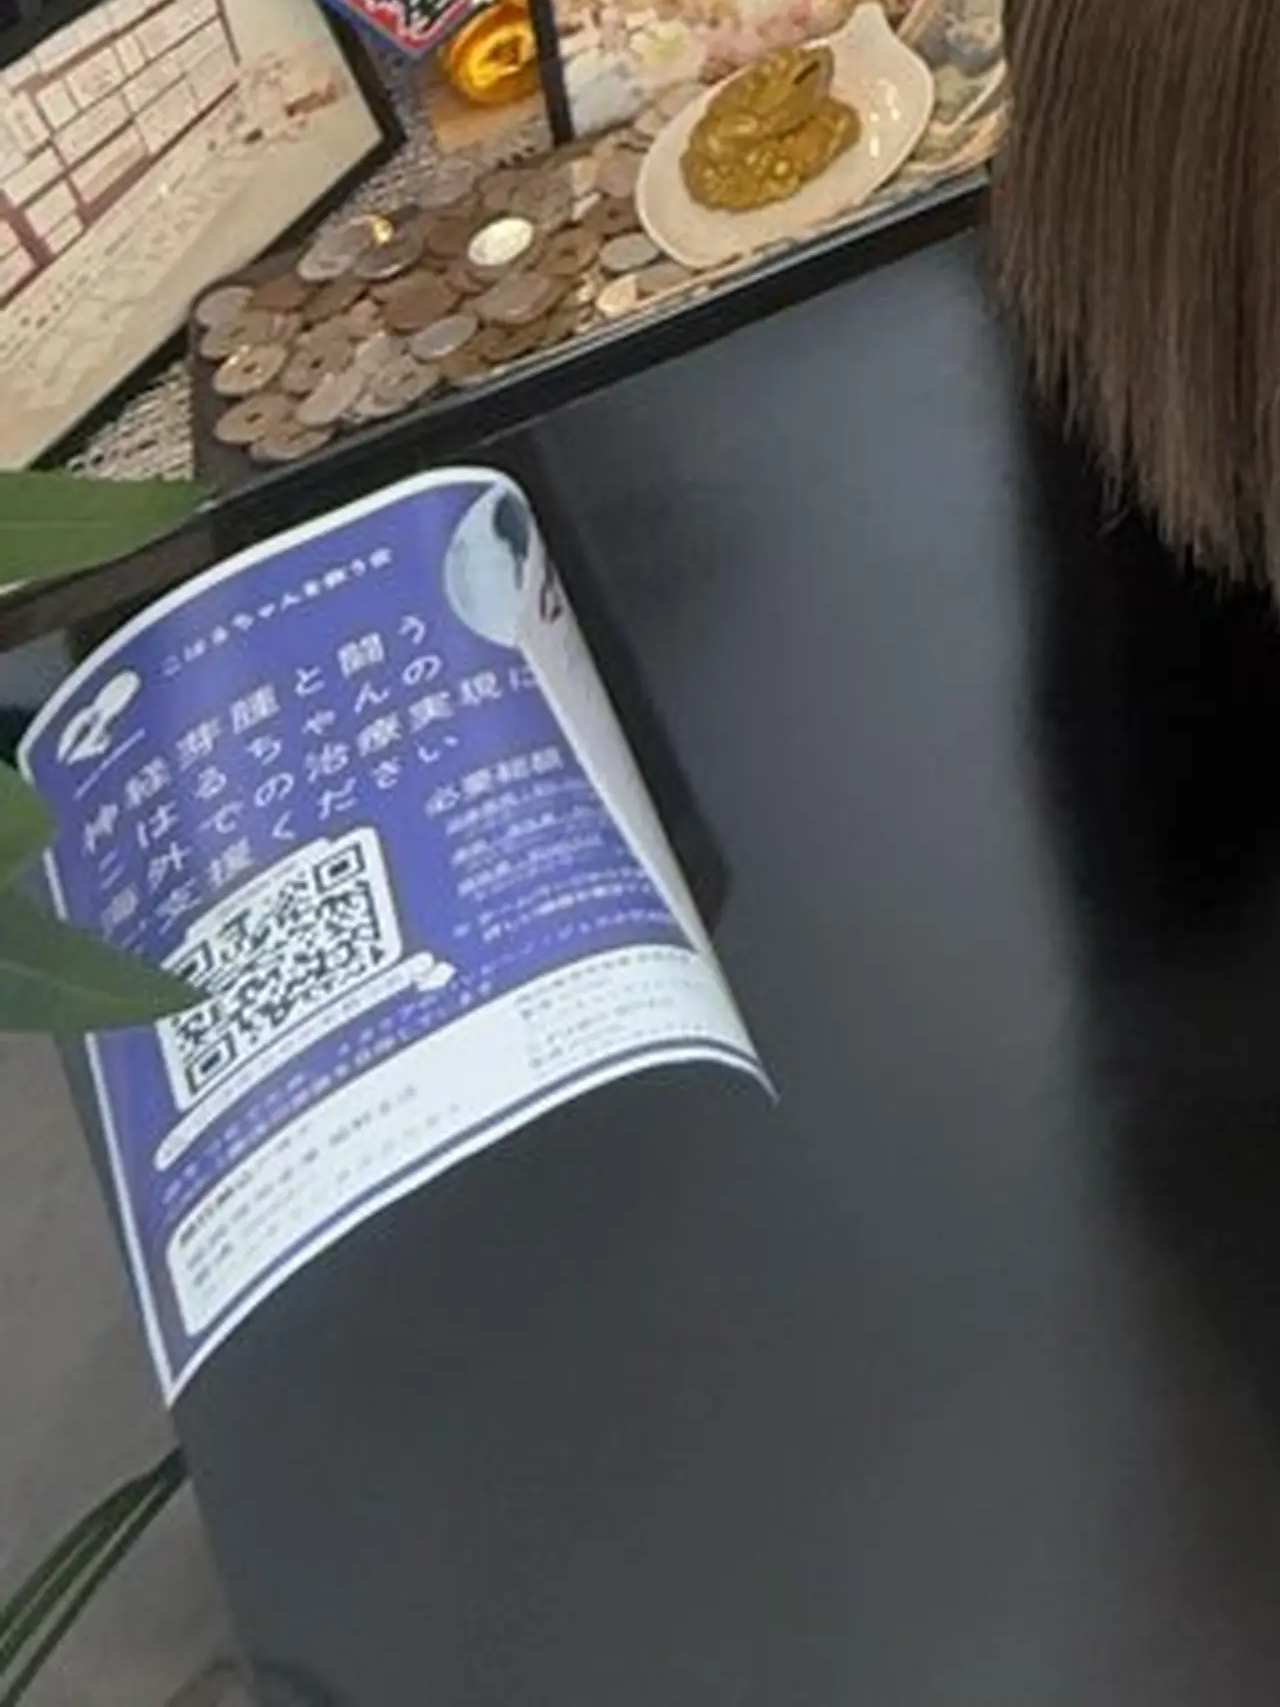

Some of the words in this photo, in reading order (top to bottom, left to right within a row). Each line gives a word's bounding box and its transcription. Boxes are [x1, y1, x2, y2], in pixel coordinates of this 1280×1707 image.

[84, 614, 427, 855] 神経芽腫と闘う
[99, 653, 443, 889] こはるちゃんの
